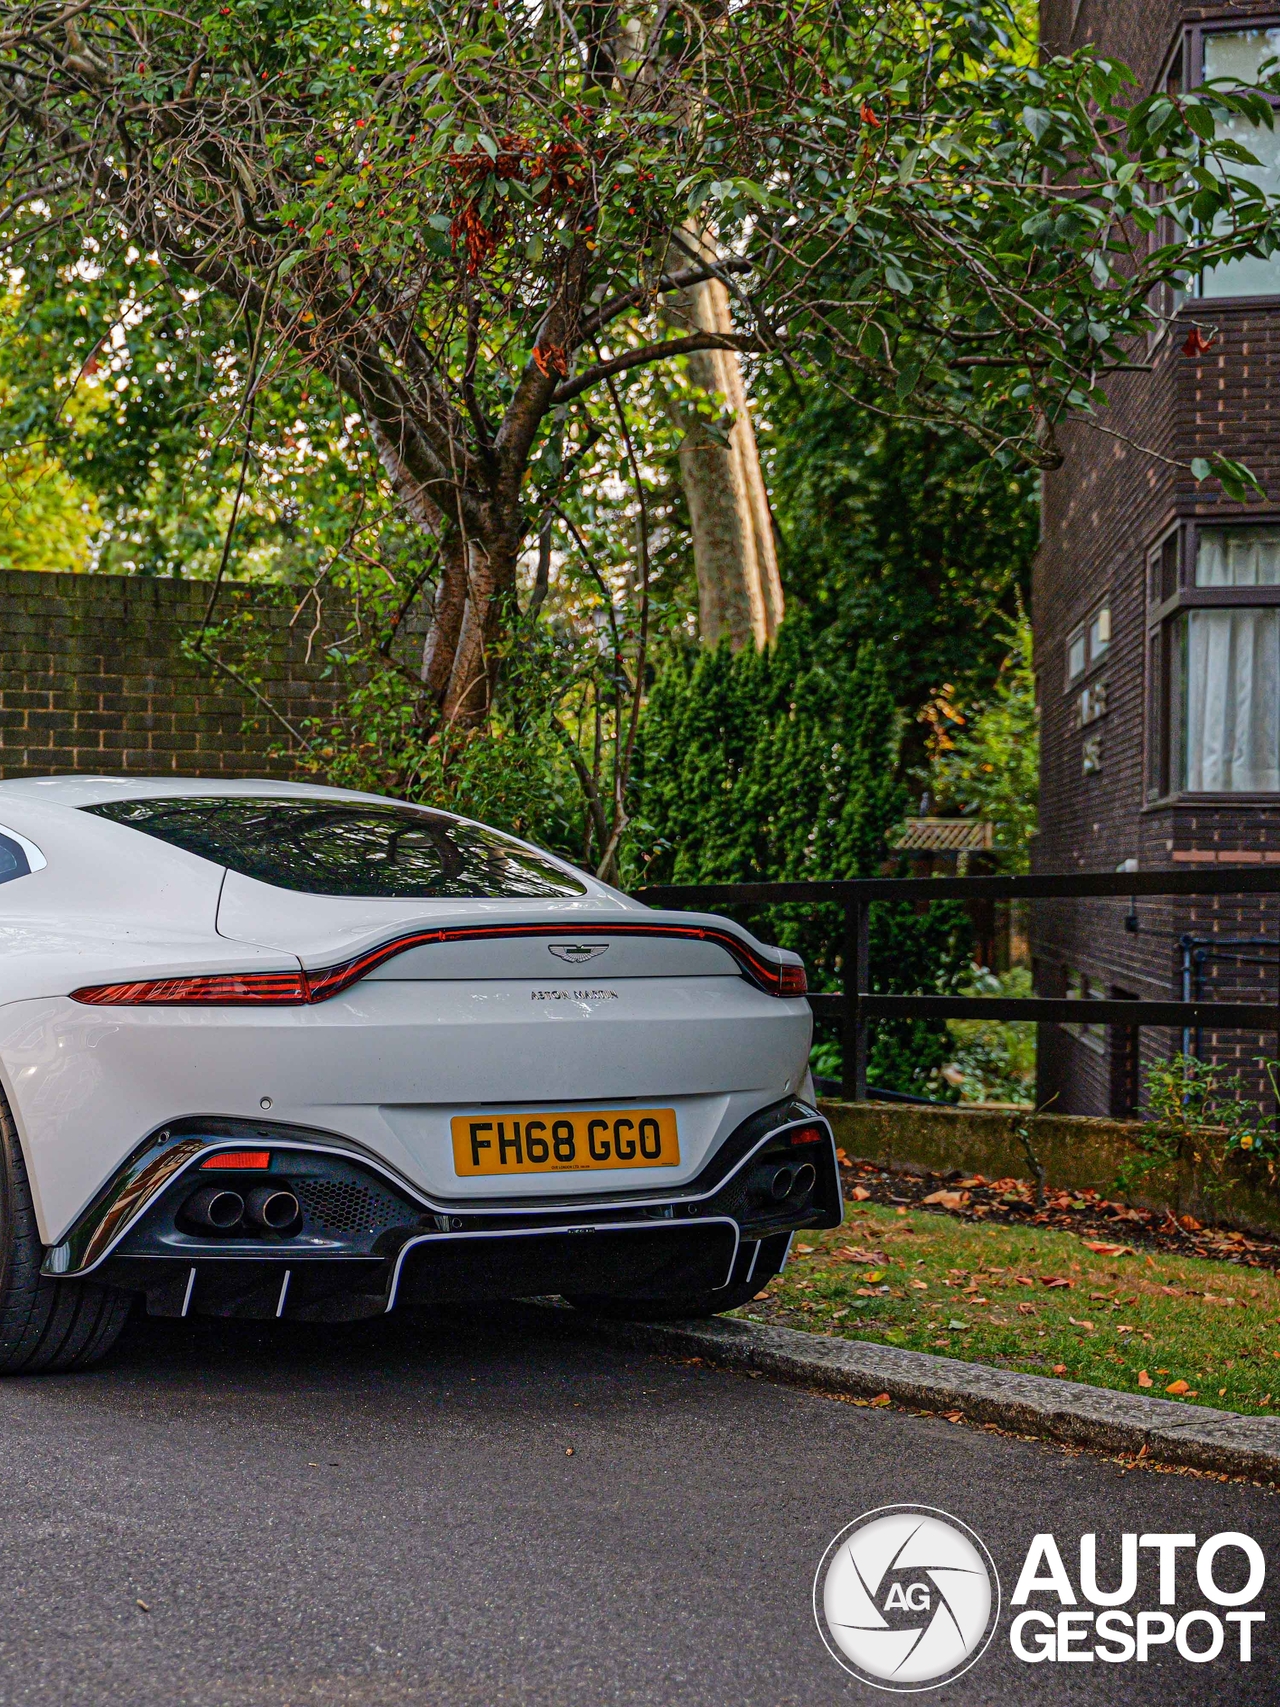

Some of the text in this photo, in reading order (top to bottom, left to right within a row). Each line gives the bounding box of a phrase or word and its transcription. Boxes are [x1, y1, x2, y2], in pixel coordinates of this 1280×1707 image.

[531, 990, 618, 1000] ASTON MARTIN
[469, 1118, 661, 1166] FH68 GGO
